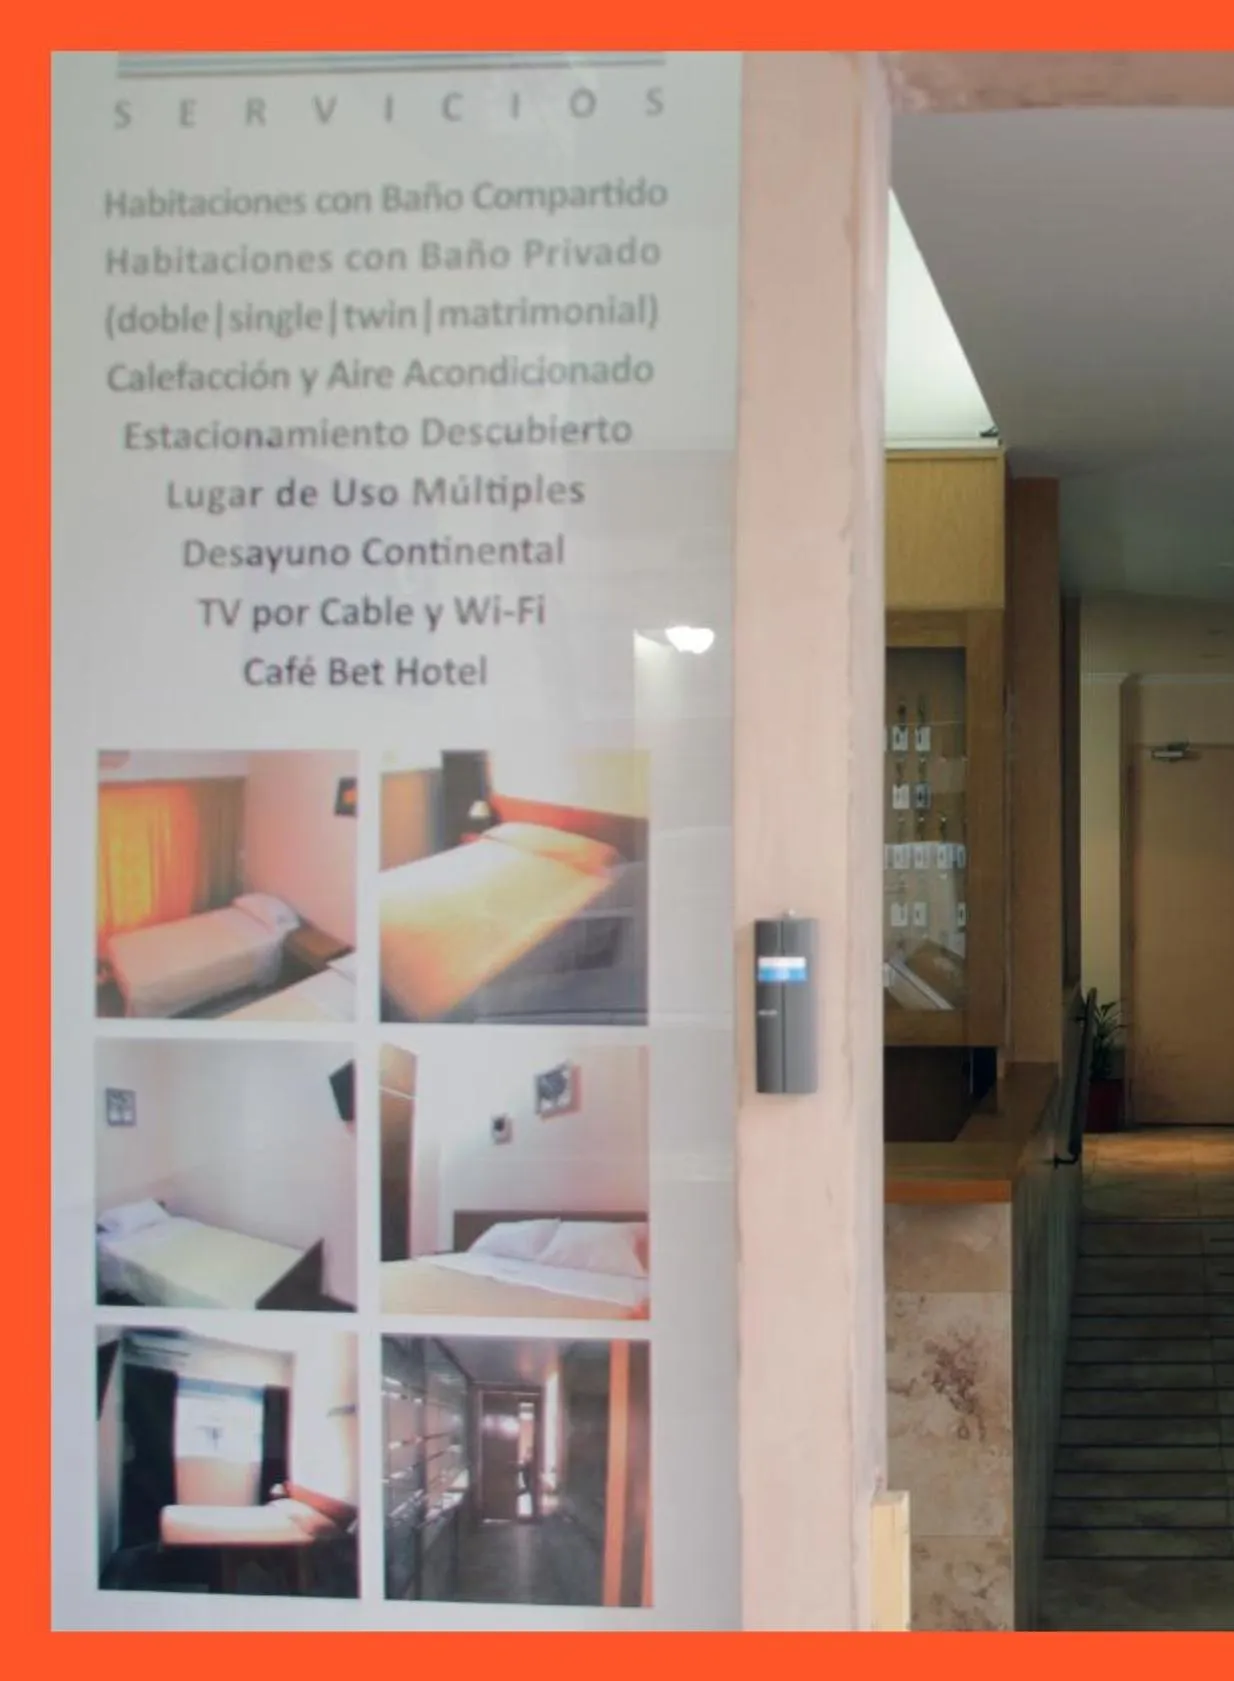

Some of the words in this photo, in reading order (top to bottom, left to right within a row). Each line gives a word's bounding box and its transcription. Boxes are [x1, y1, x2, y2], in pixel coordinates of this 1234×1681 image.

[113, 86, 665, 129] SERVICIOS
[103, 187, 307, 219] Habitaciones
[314, 191, 372, 216] con
[382, 182, 465, 214] Baño
[472, 176, 669, 215] Compartido
[105, 244, 333, 276] Habitaciones
[344, 247, 408, 273] con
[420, 238, 512, 271] Baño
[523, 235, 662, 269] Privado
[106, 361, 291, 394] Calefacción
[300, 369, 318, 397] y
[326, 356, 395, 390] Aire
[403, 354, 655, 389] Acondicionado
[122, 418, 409, 451] Estacionamiento
[421, 415, 633, 447] Descubierto
[167, 480, 264, 515] Lugar
[275, 476, 318, 508] de
[331, 478, 399, 508] Uso
[412, 473, 586, 511] Múltiples
[182, 537, 351, 573] Desayuno
[361, 533, 566, 567] Continental
[198, 596, 242, 628] TV
[252, 603, 309, 633] por
[319, 595, 414, 627] Cable
[425, 602, 444, 632] y
[454, 593, 546, 627] Wi-Fi
[243, 655, 317, 687] Café
[329, 656, 385, 686] Bet
[395, 654, 488, 687] Hotel
